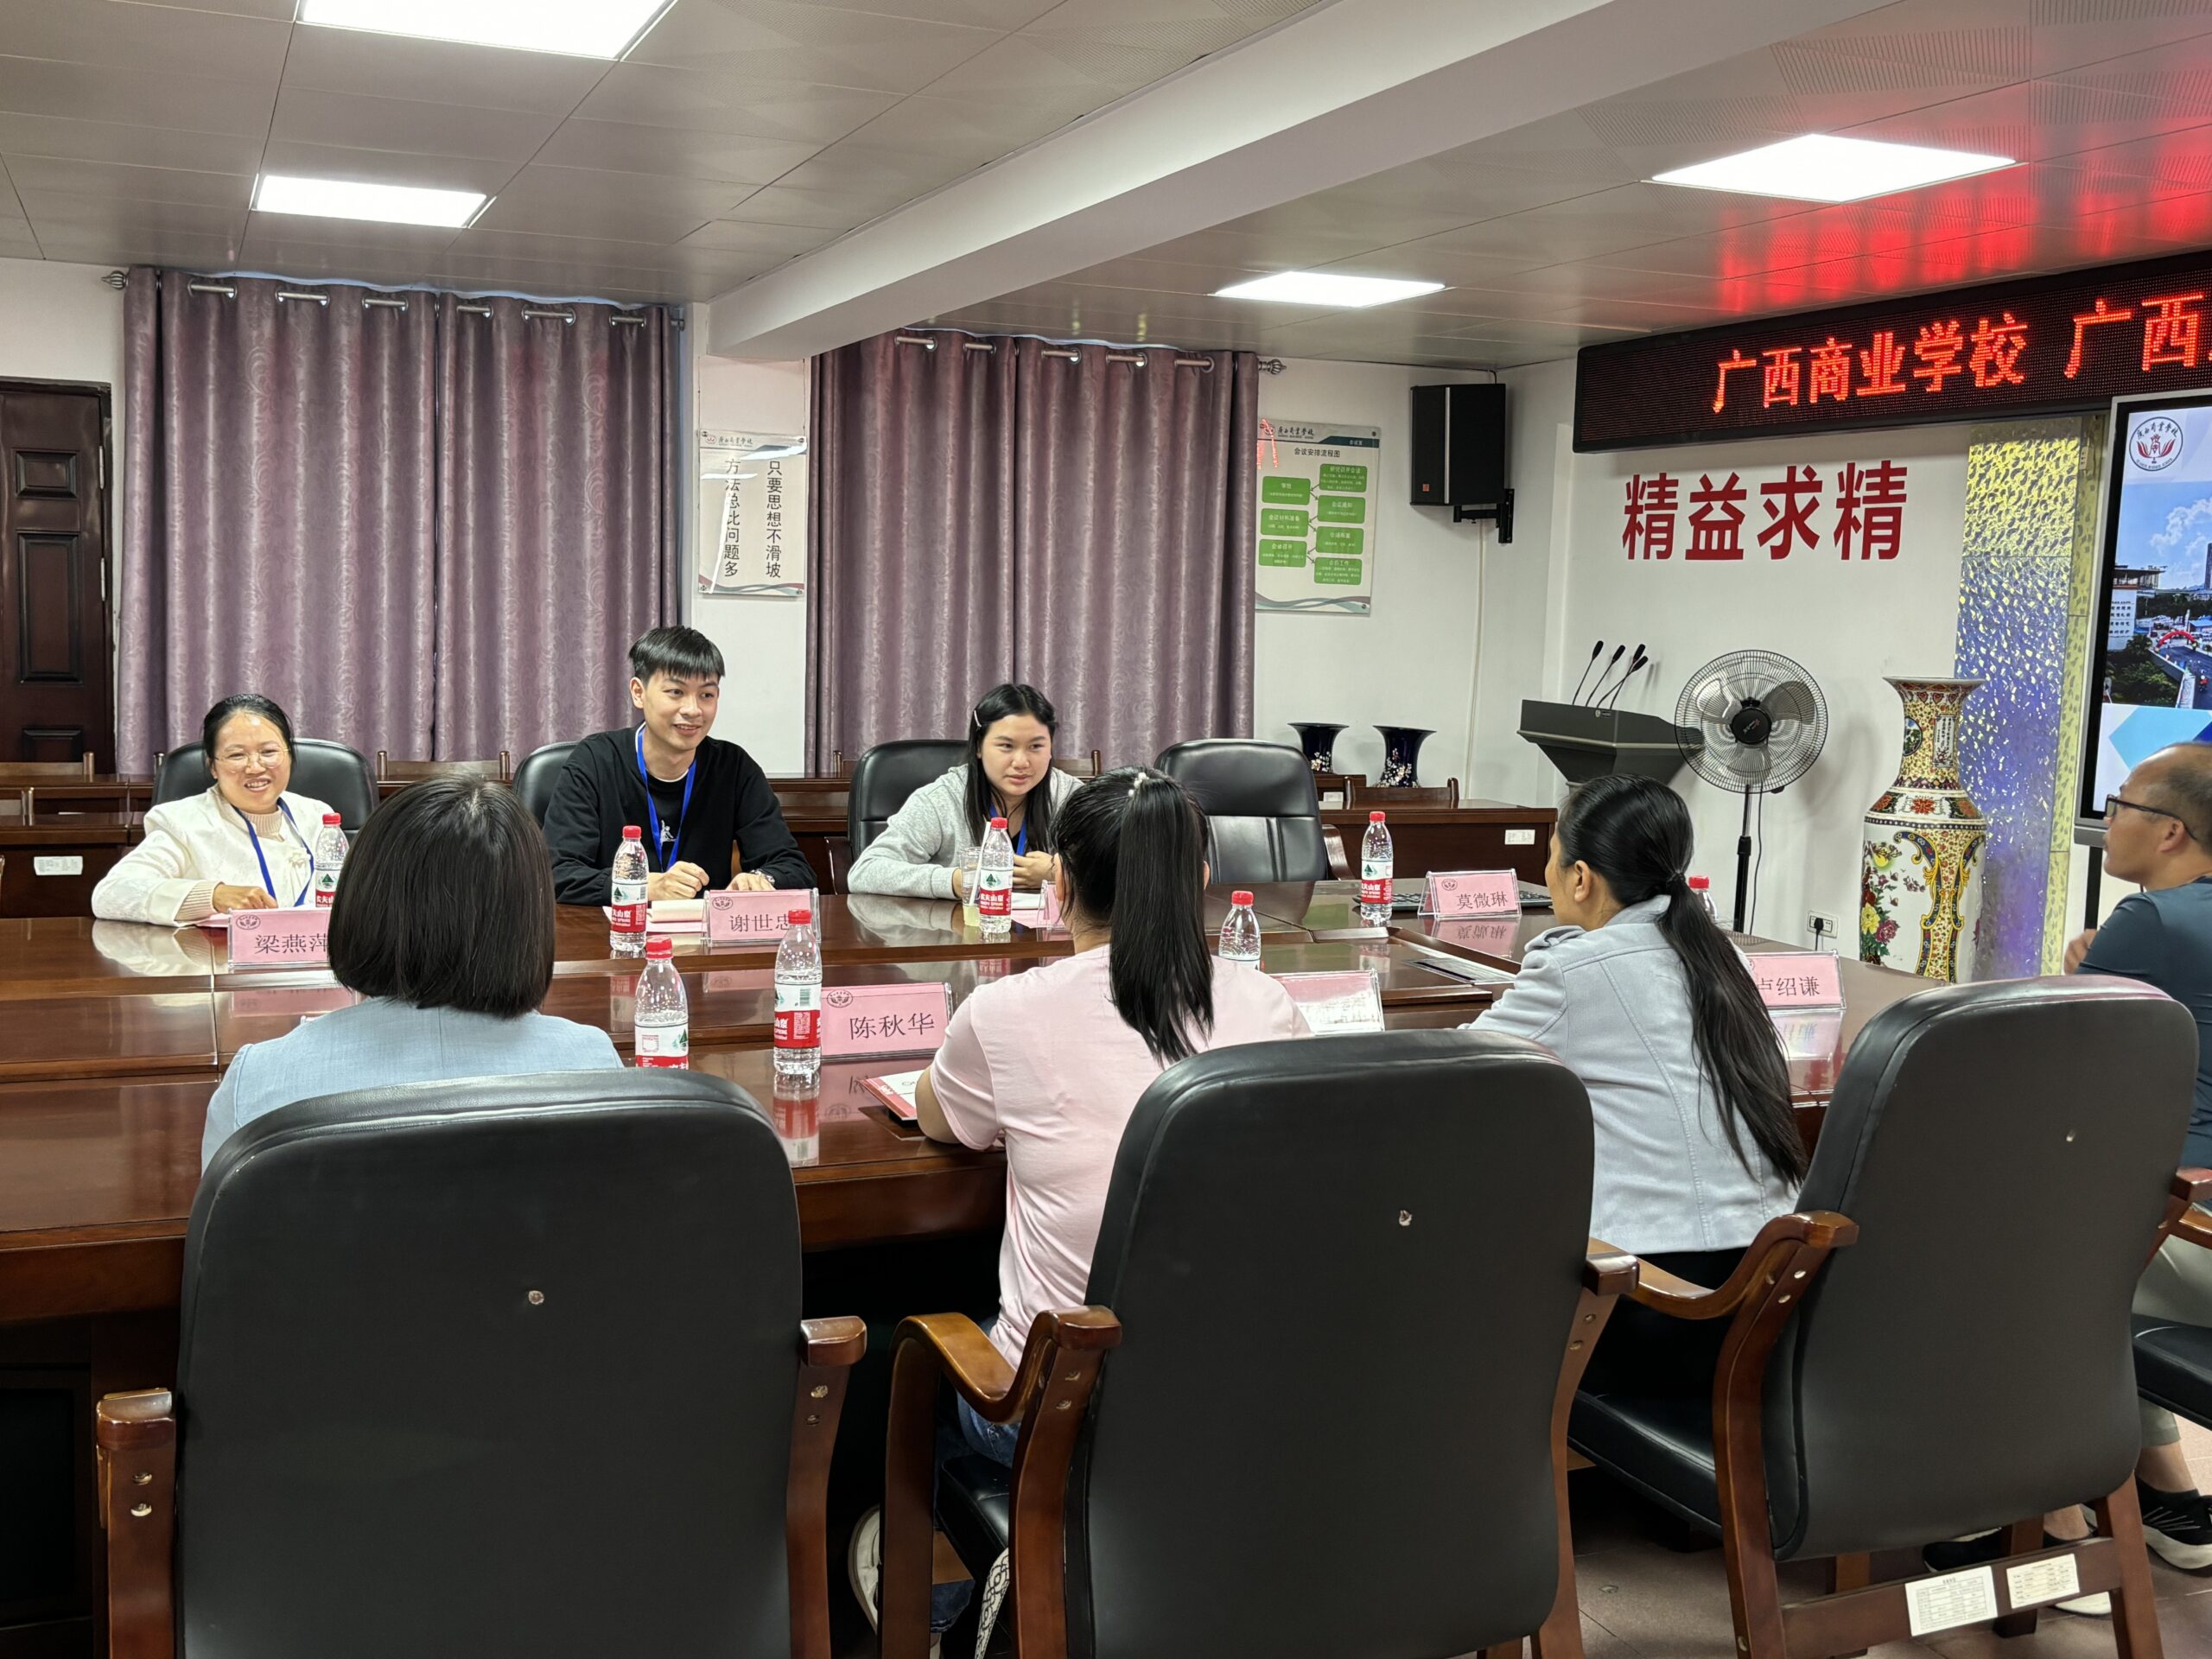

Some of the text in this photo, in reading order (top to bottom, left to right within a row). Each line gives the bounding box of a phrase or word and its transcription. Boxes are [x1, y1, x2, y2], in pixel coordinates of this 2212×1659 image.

[1712, 293, 2212, 413] 广西商业学校 广西
[1294, 448, 1340, 458] 会议安排流程图
[723, 458, 741, 577] 方法总比问题多
[766, 461, 783, 579] 只要思想不滑坡
[1622, 460, 1907, 561] 精益求精
[1456, 892, 1509, 910] 莫微琳
[254, 933, 328, 954] 梁燕萍
[849, 1013, 936, 1040] 陈秋华
